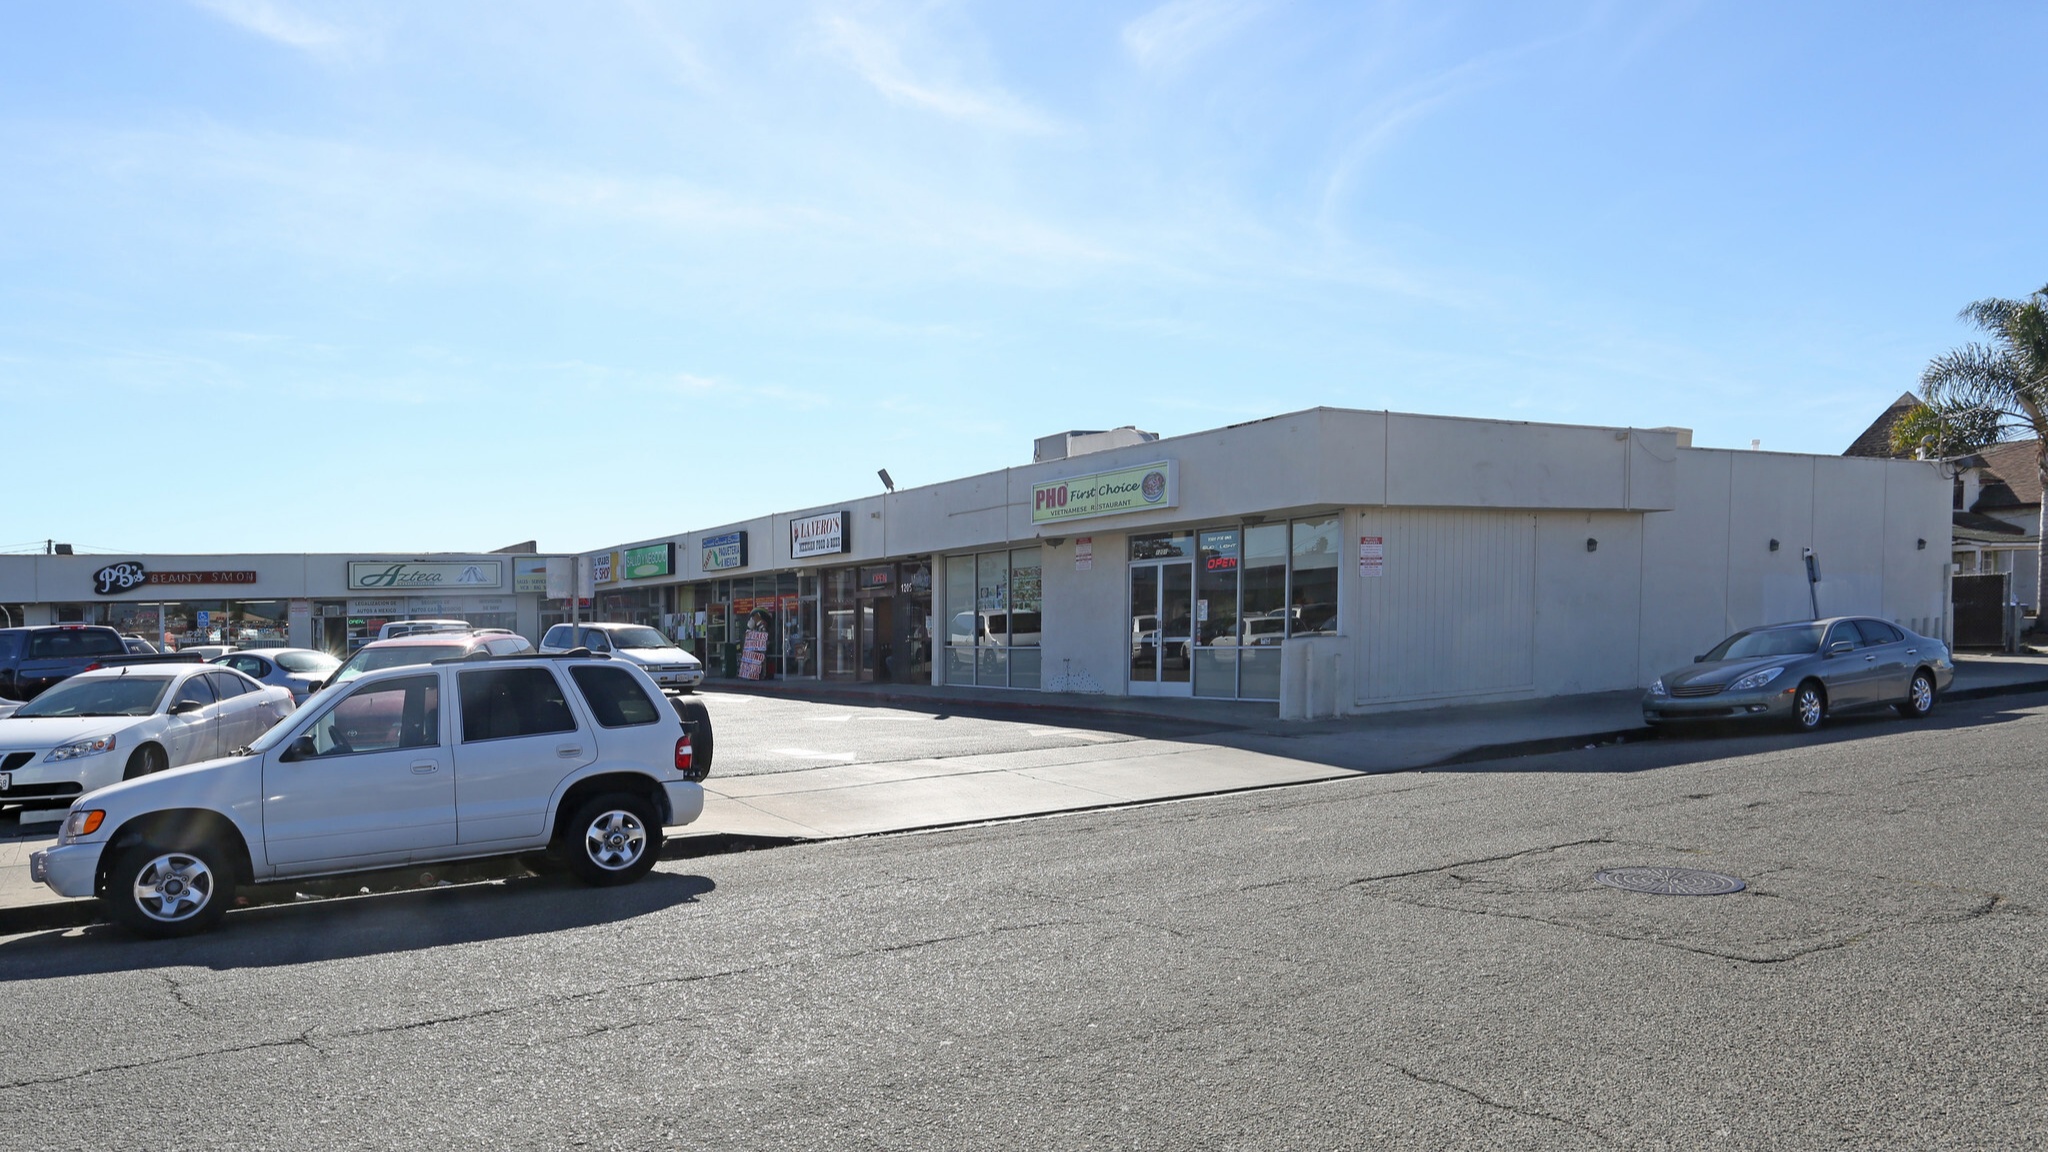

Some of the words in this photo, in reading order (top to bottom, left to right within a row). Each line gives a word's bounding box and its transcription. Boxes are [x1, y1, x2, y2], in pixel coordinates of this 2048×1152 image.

[1070, 487, 1096, 502] First
[1098, 482, 1140, 496] Choice
[1050, 506, 1087, 516] VIETNAMESE
[1207, 557, 1236, 569] OPEN
[100, 564, 145, 592] PB's
[152, 574, 202, 583] BEAUTY
[360, 564, 442, 586] Azteca
[873, 573, 887, 583] OPEN
